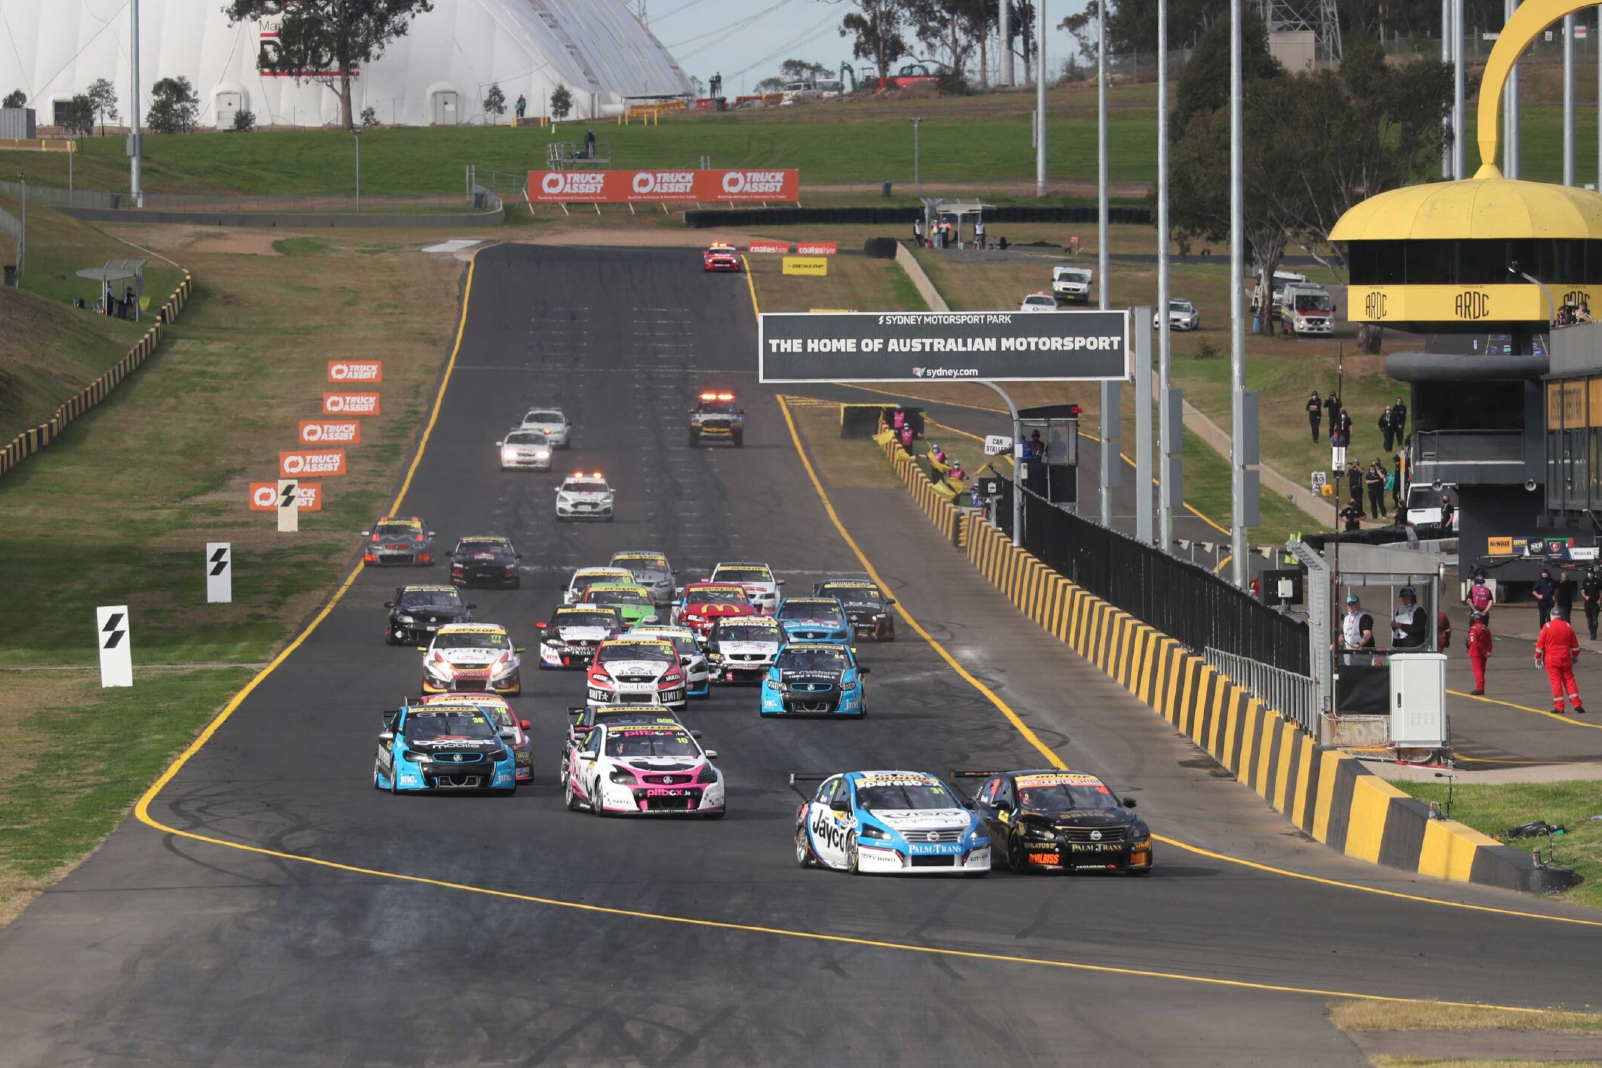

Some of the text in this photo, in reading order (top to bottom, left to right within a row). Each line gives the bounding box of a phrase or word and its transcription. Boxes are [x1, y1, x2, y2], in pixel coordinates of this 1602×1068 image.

[566, 173, 605, 183] TRUCK
[656, 172, 695, 182] TRUCK
[745, 172, 785, 182] TRUCK
[563, 183, 604, 194] ASSIST
[653, 182, 693, 193] ASSIST
[742, 182, 783, 192] ASSIST
[1365, 291, 1388, 320] ARDC
[1455, 291, 1490, 320] ARDC
[885, 314, 1012, 325] SYDNEY MOTORSPORT PARK
[768, 336, 1122, 353] THE HOME OF AUSTRALIAN MOTORSPORT
[349, 364, 378, 372] TRUCK
[926, 366, 979, 378] sydney.com
[347, 371, 377, 379] ASSIST
[345, 396, 376, 404] TRUCK
[343, 403, 375, 412] ASSIST
[323, 424, 356, 433] TRUCK
[320, 432, 355, 441] ASSIST
[992, 438, 1004, 446] CAR
[305, 454, 342, 464] TRUCK
[303, 463, 340, 473] ASSIST
[812, 809, 846, 853] Jayco
[908, 843, 962, 854] PALM TRANS
[1071, 843, 1095, 853] PALM
[1096, 842, 1123, 852] TRANS
